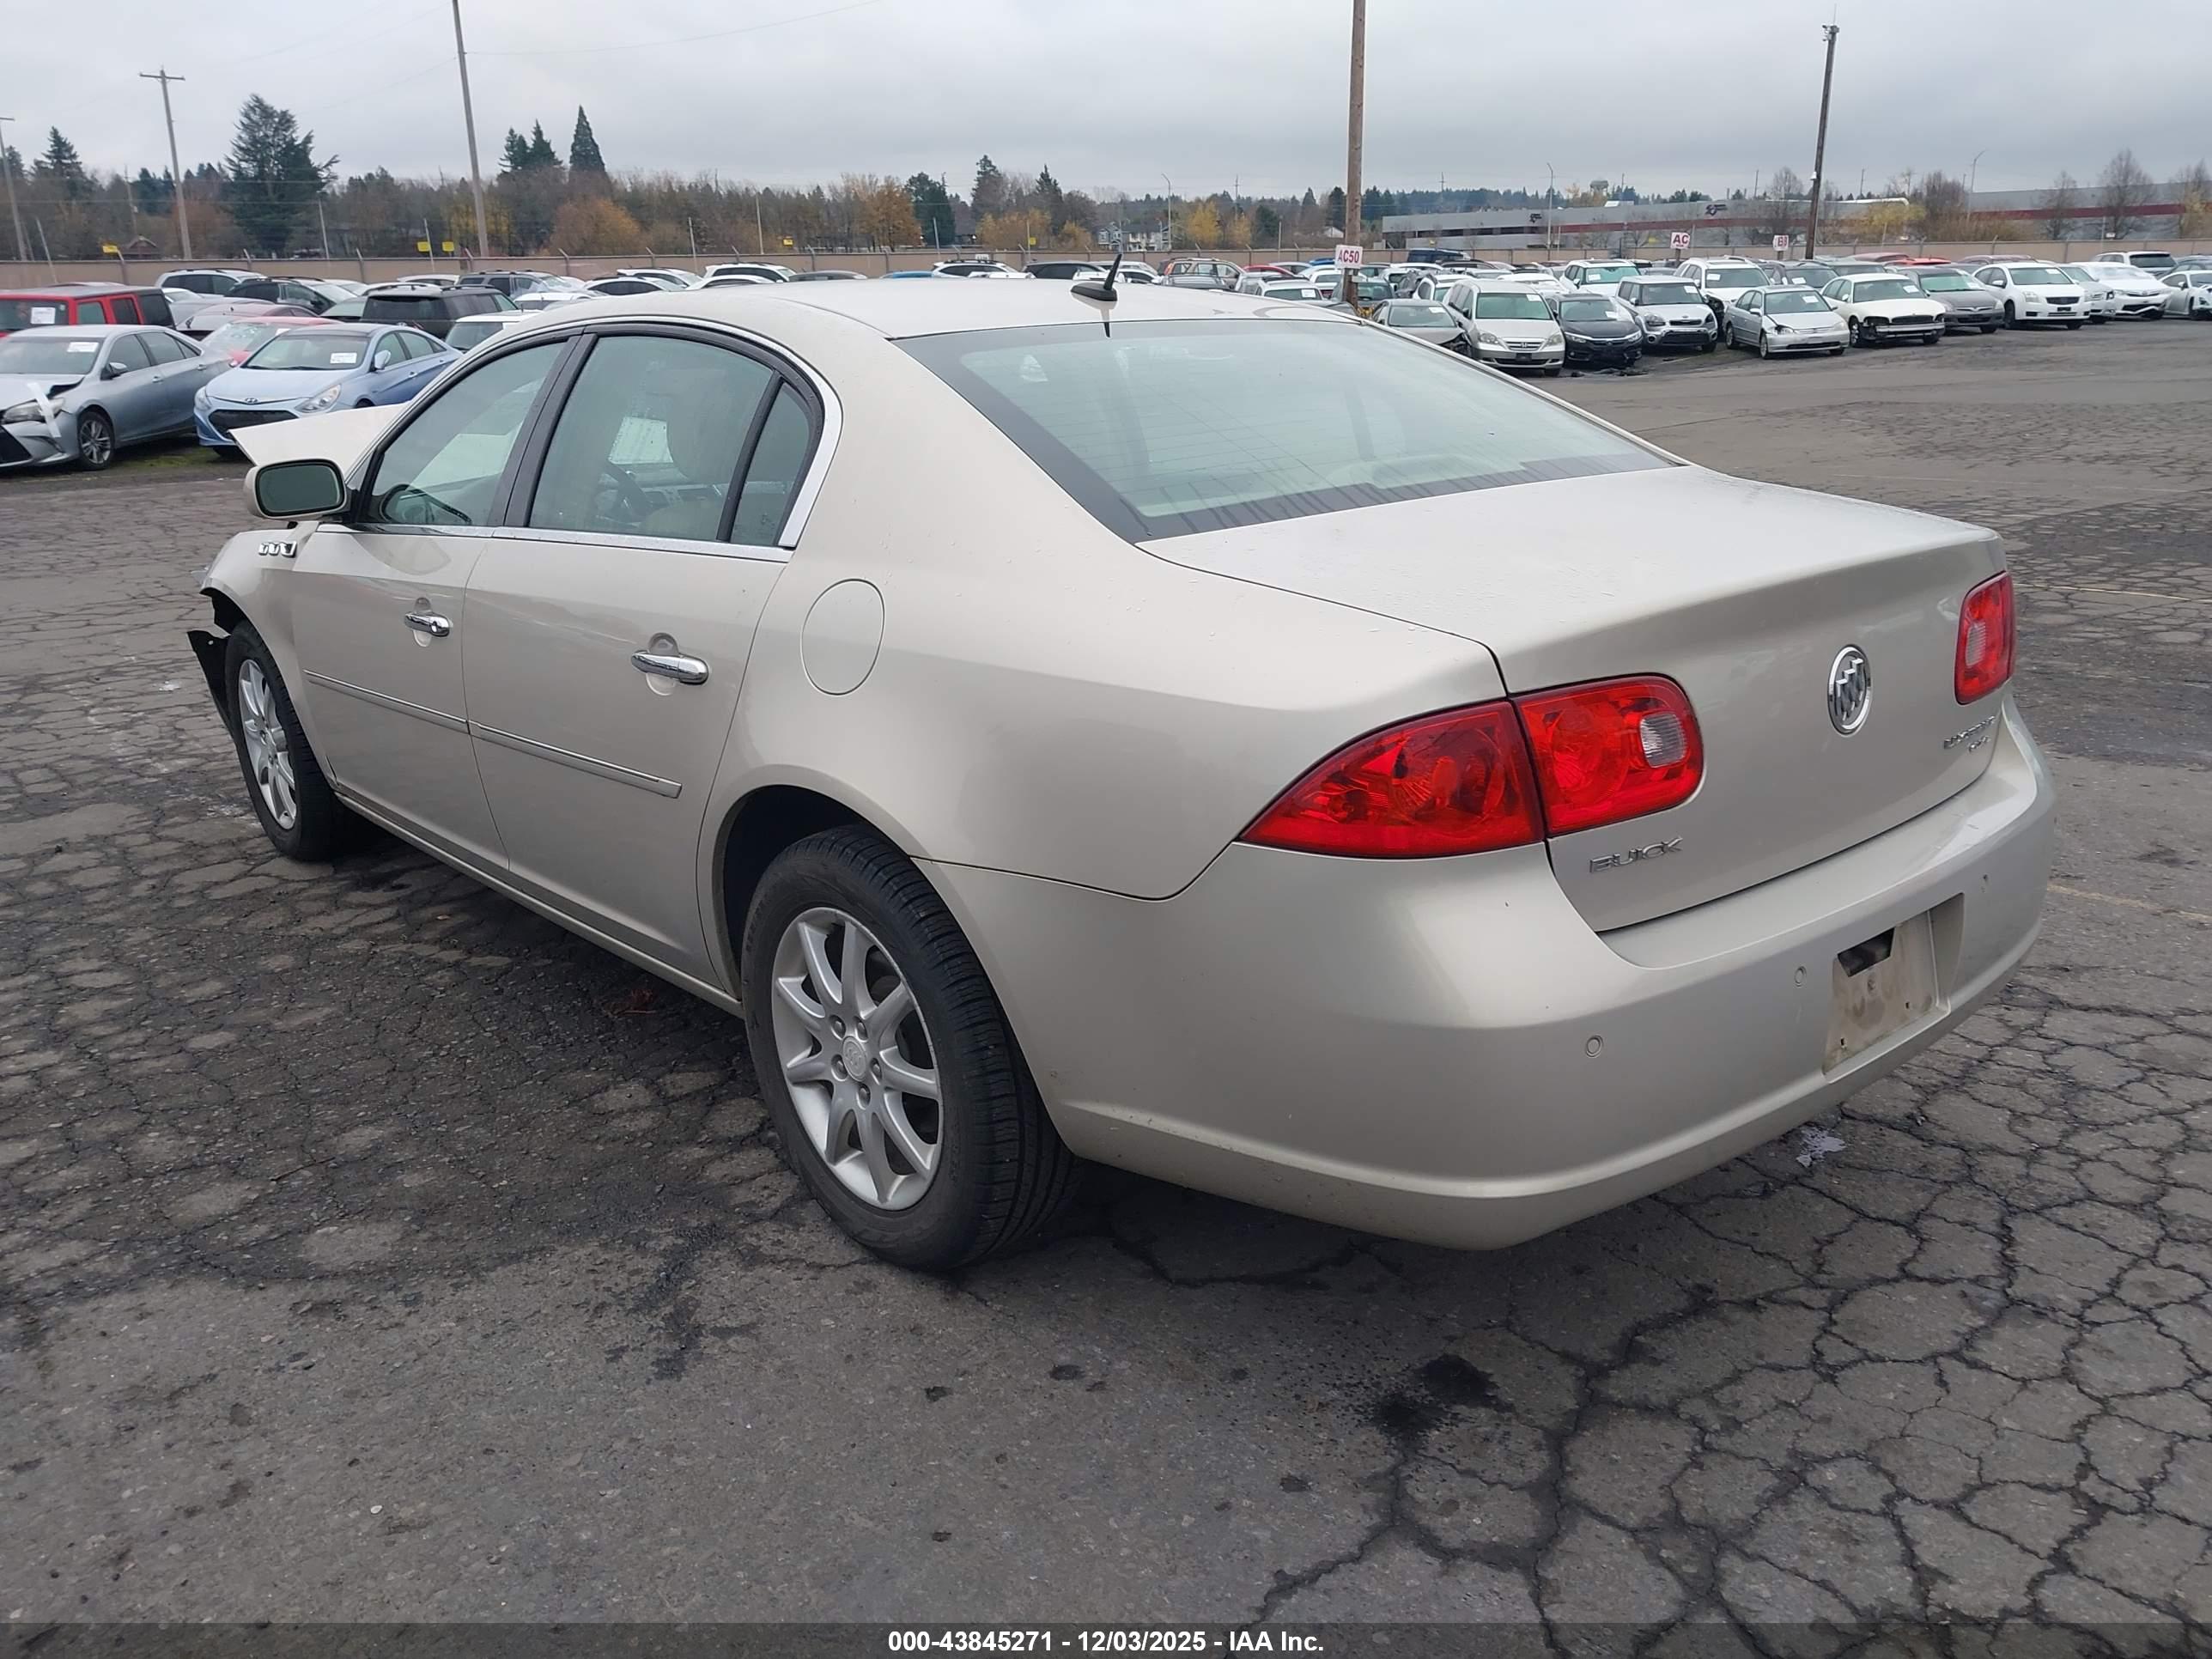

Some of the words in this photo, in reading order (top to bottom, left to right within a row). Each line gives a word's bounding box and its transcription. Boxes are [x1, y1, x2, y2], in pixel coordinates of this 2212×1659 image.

[1673, 234, 1689, 245] AC
[1338, 250, 1360, 264] AC50
[1589, 836, 1683, 872] BUICK
